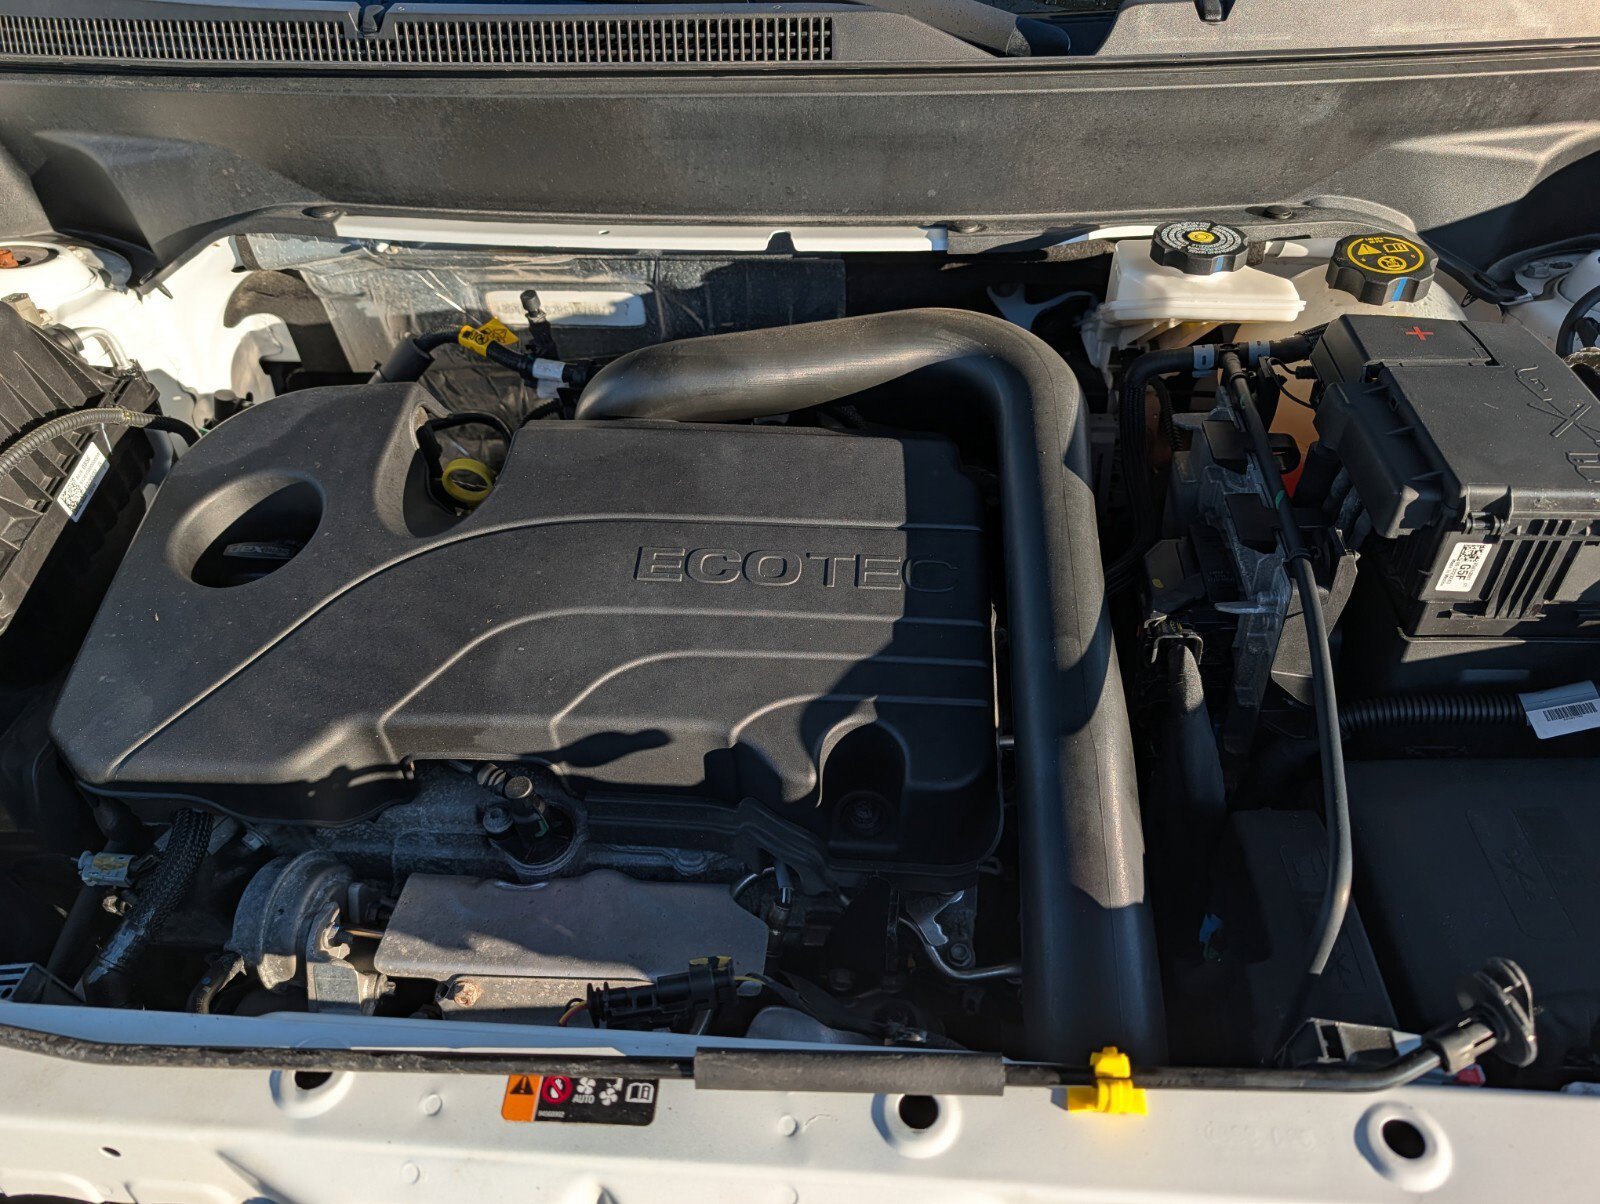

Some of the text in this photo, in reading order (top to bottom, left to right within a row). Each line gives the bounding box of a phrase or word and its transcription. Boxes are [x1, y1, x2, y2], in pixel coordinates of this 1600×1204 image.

[632, 546, 959, 593] ECOTEC
[1455, 564, 1472, 580] G5F
[571, 1094, 596, 1104] AUTO
